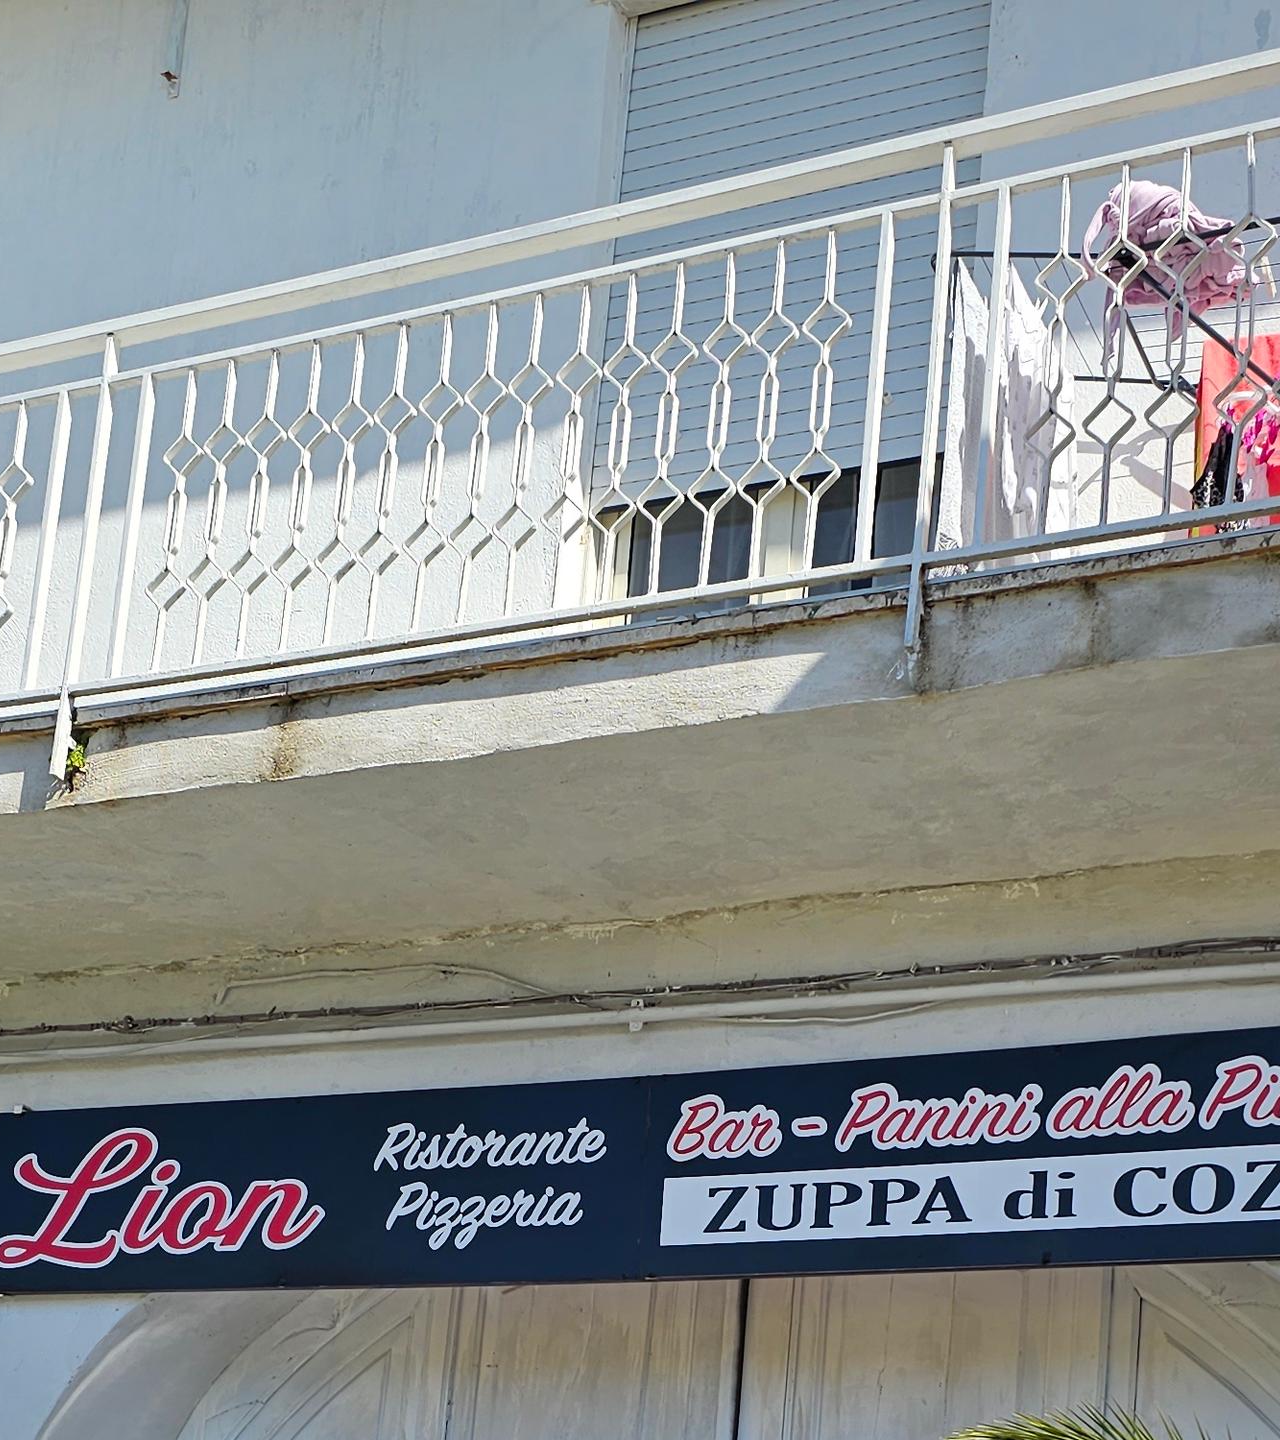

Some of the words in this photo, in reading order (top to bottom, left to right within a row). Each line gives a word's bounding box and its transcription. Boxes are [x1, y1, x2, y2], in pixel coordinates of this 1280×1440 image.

[374, 1117, 606, 1171] Ristorante
[667, 1094, 782, 1162] Bar
[835, 1083, 1043, 1152] Panini
[1046, 1064, 1195, 1139] alla
[386, 1182, 583, 1250] Pizzeria
[703, 1176, 972, 1233] ZUPPA
[1004, 1171, 1077, 1219] di
